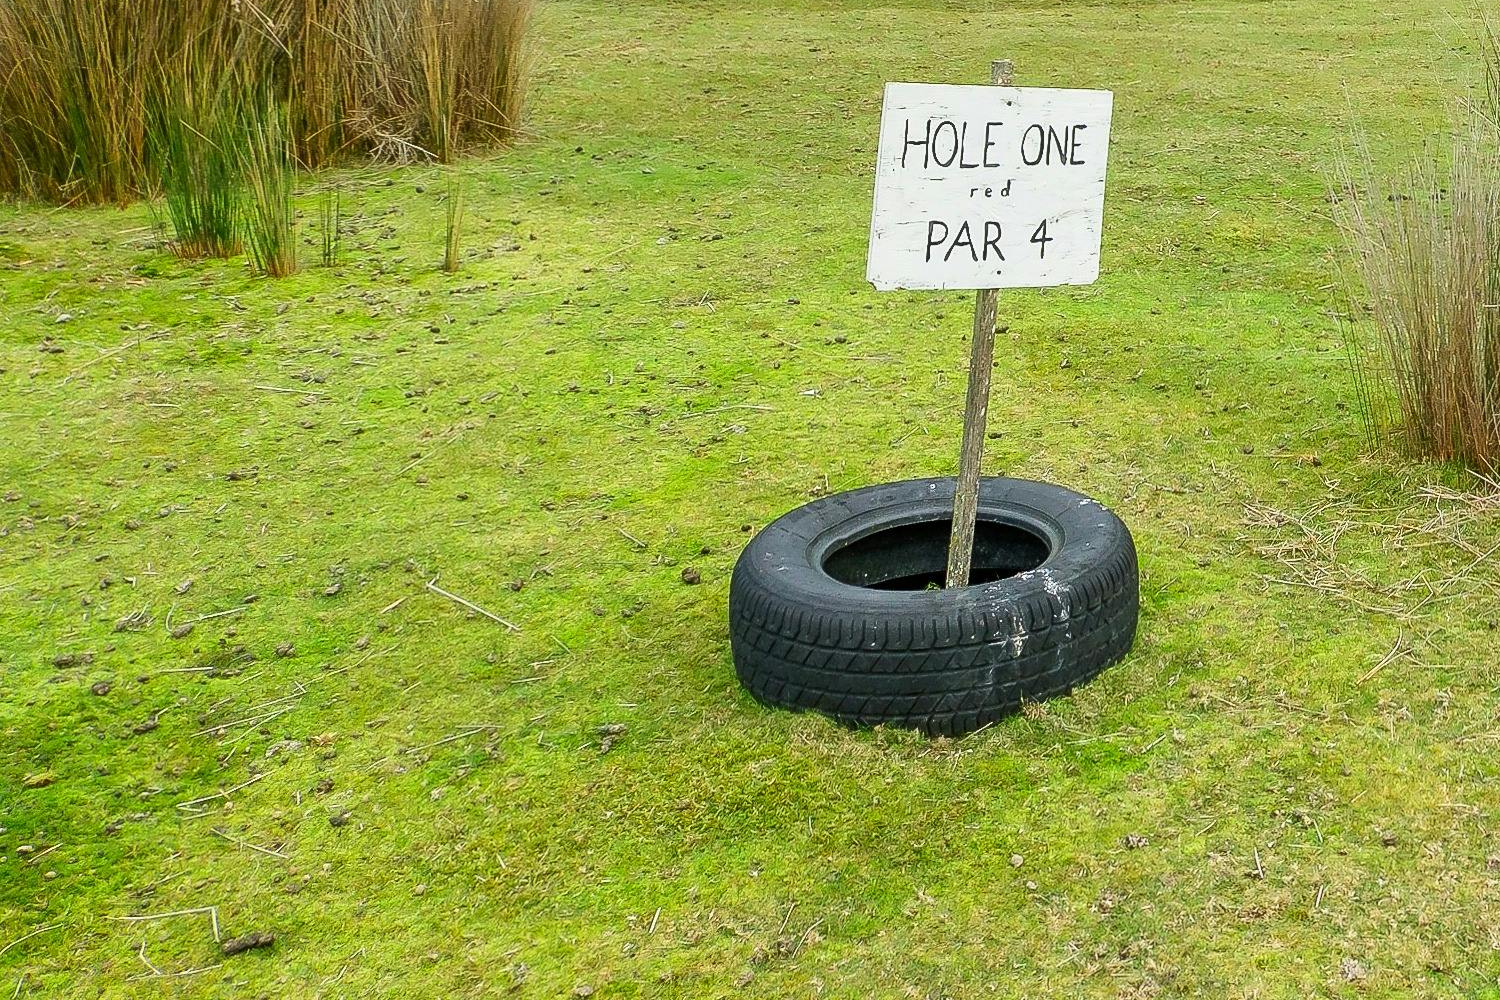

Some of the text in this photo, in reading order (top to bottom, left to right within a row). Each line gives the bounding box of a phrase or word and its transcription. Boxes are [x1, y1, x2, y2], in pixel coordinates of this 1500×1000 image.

[901, 118, 1088, 169] HOLE ONE
[969, 178, 1013, 199] red
[925, 218, 1054, 263] PAR 4
